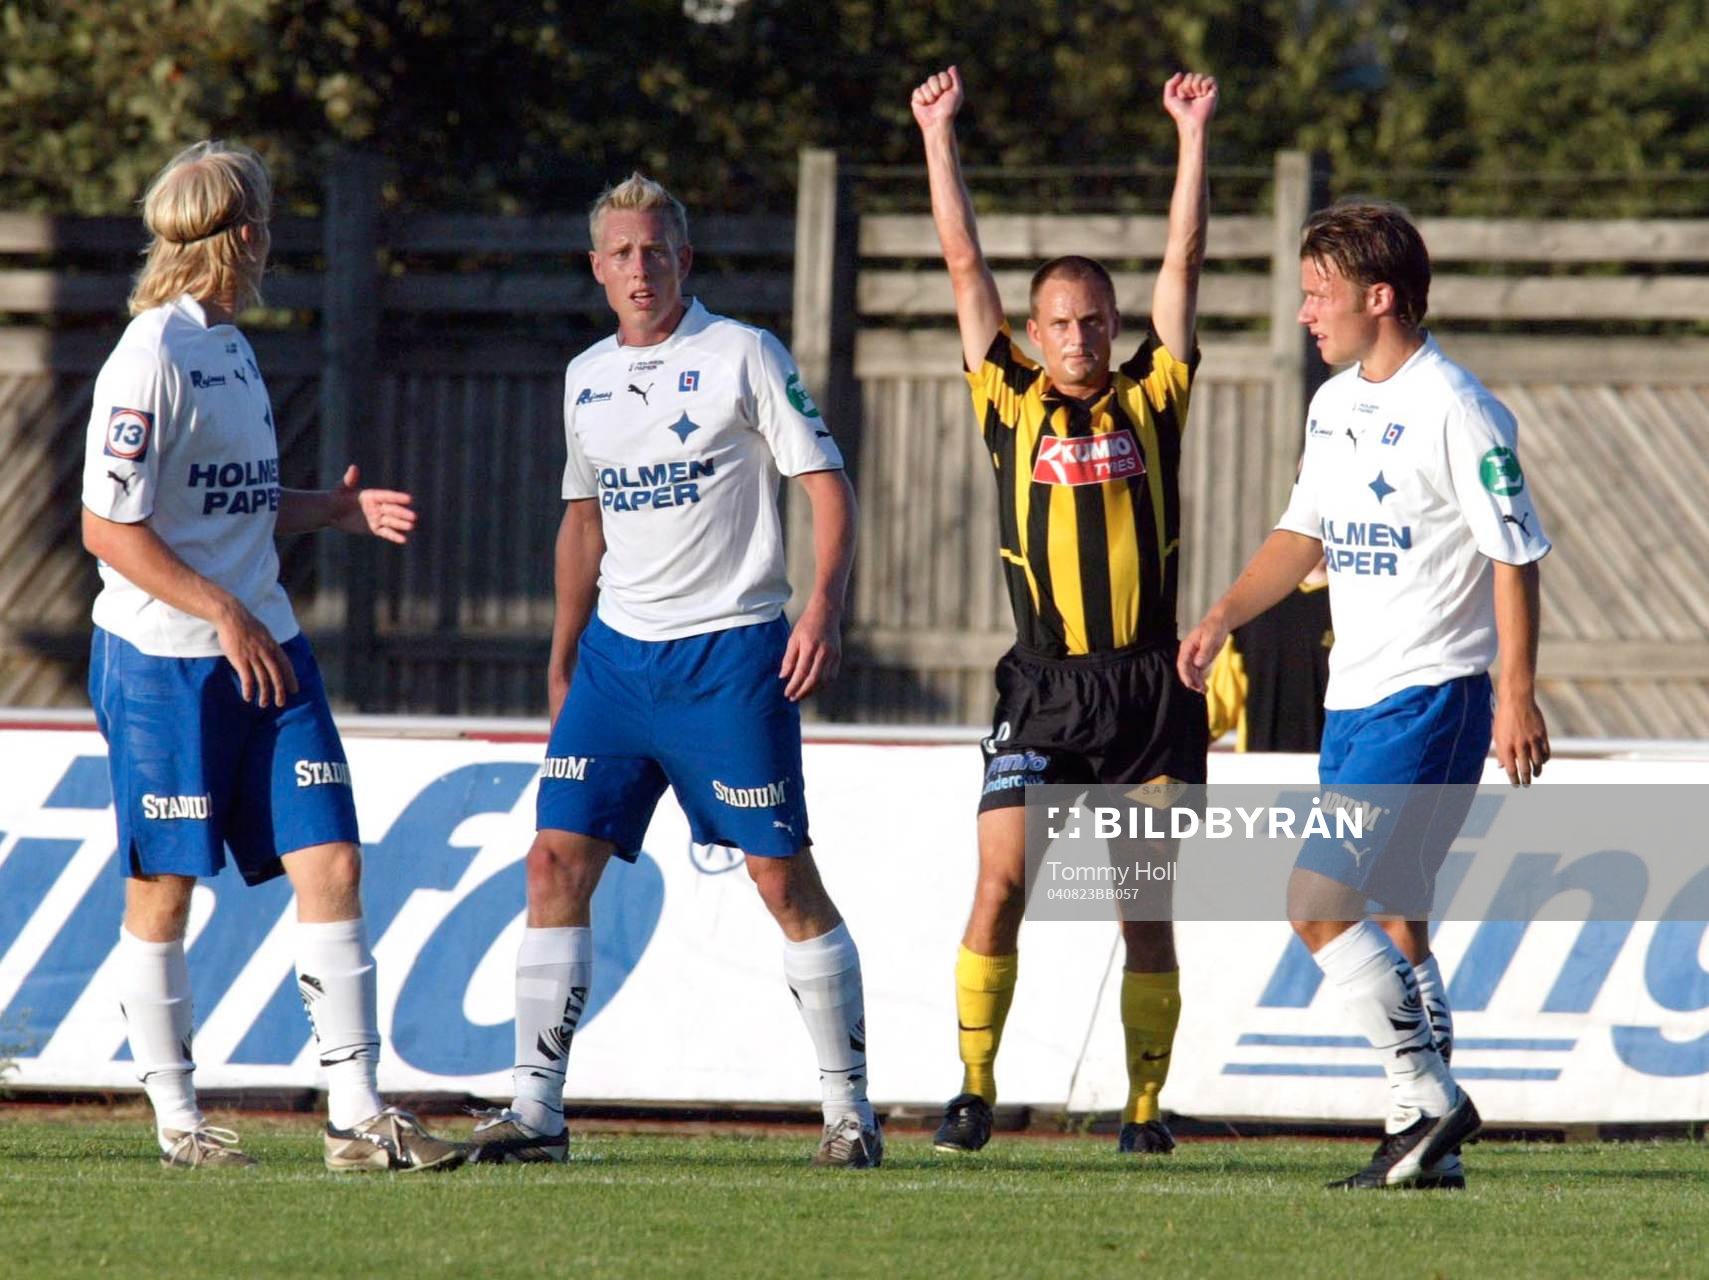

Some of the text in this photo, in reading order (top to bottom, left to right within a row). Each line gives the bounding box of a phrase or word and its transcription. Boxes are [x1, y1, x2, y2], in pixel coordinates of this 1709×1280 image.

[113, 421, 144, 445] 13
[596, 457, 716, 489] OLMEN
[602, 482, 701, 512] PAPER
[141, 792, 213, 820] STADIU
[712, 779, 786, 808] STADIUM
